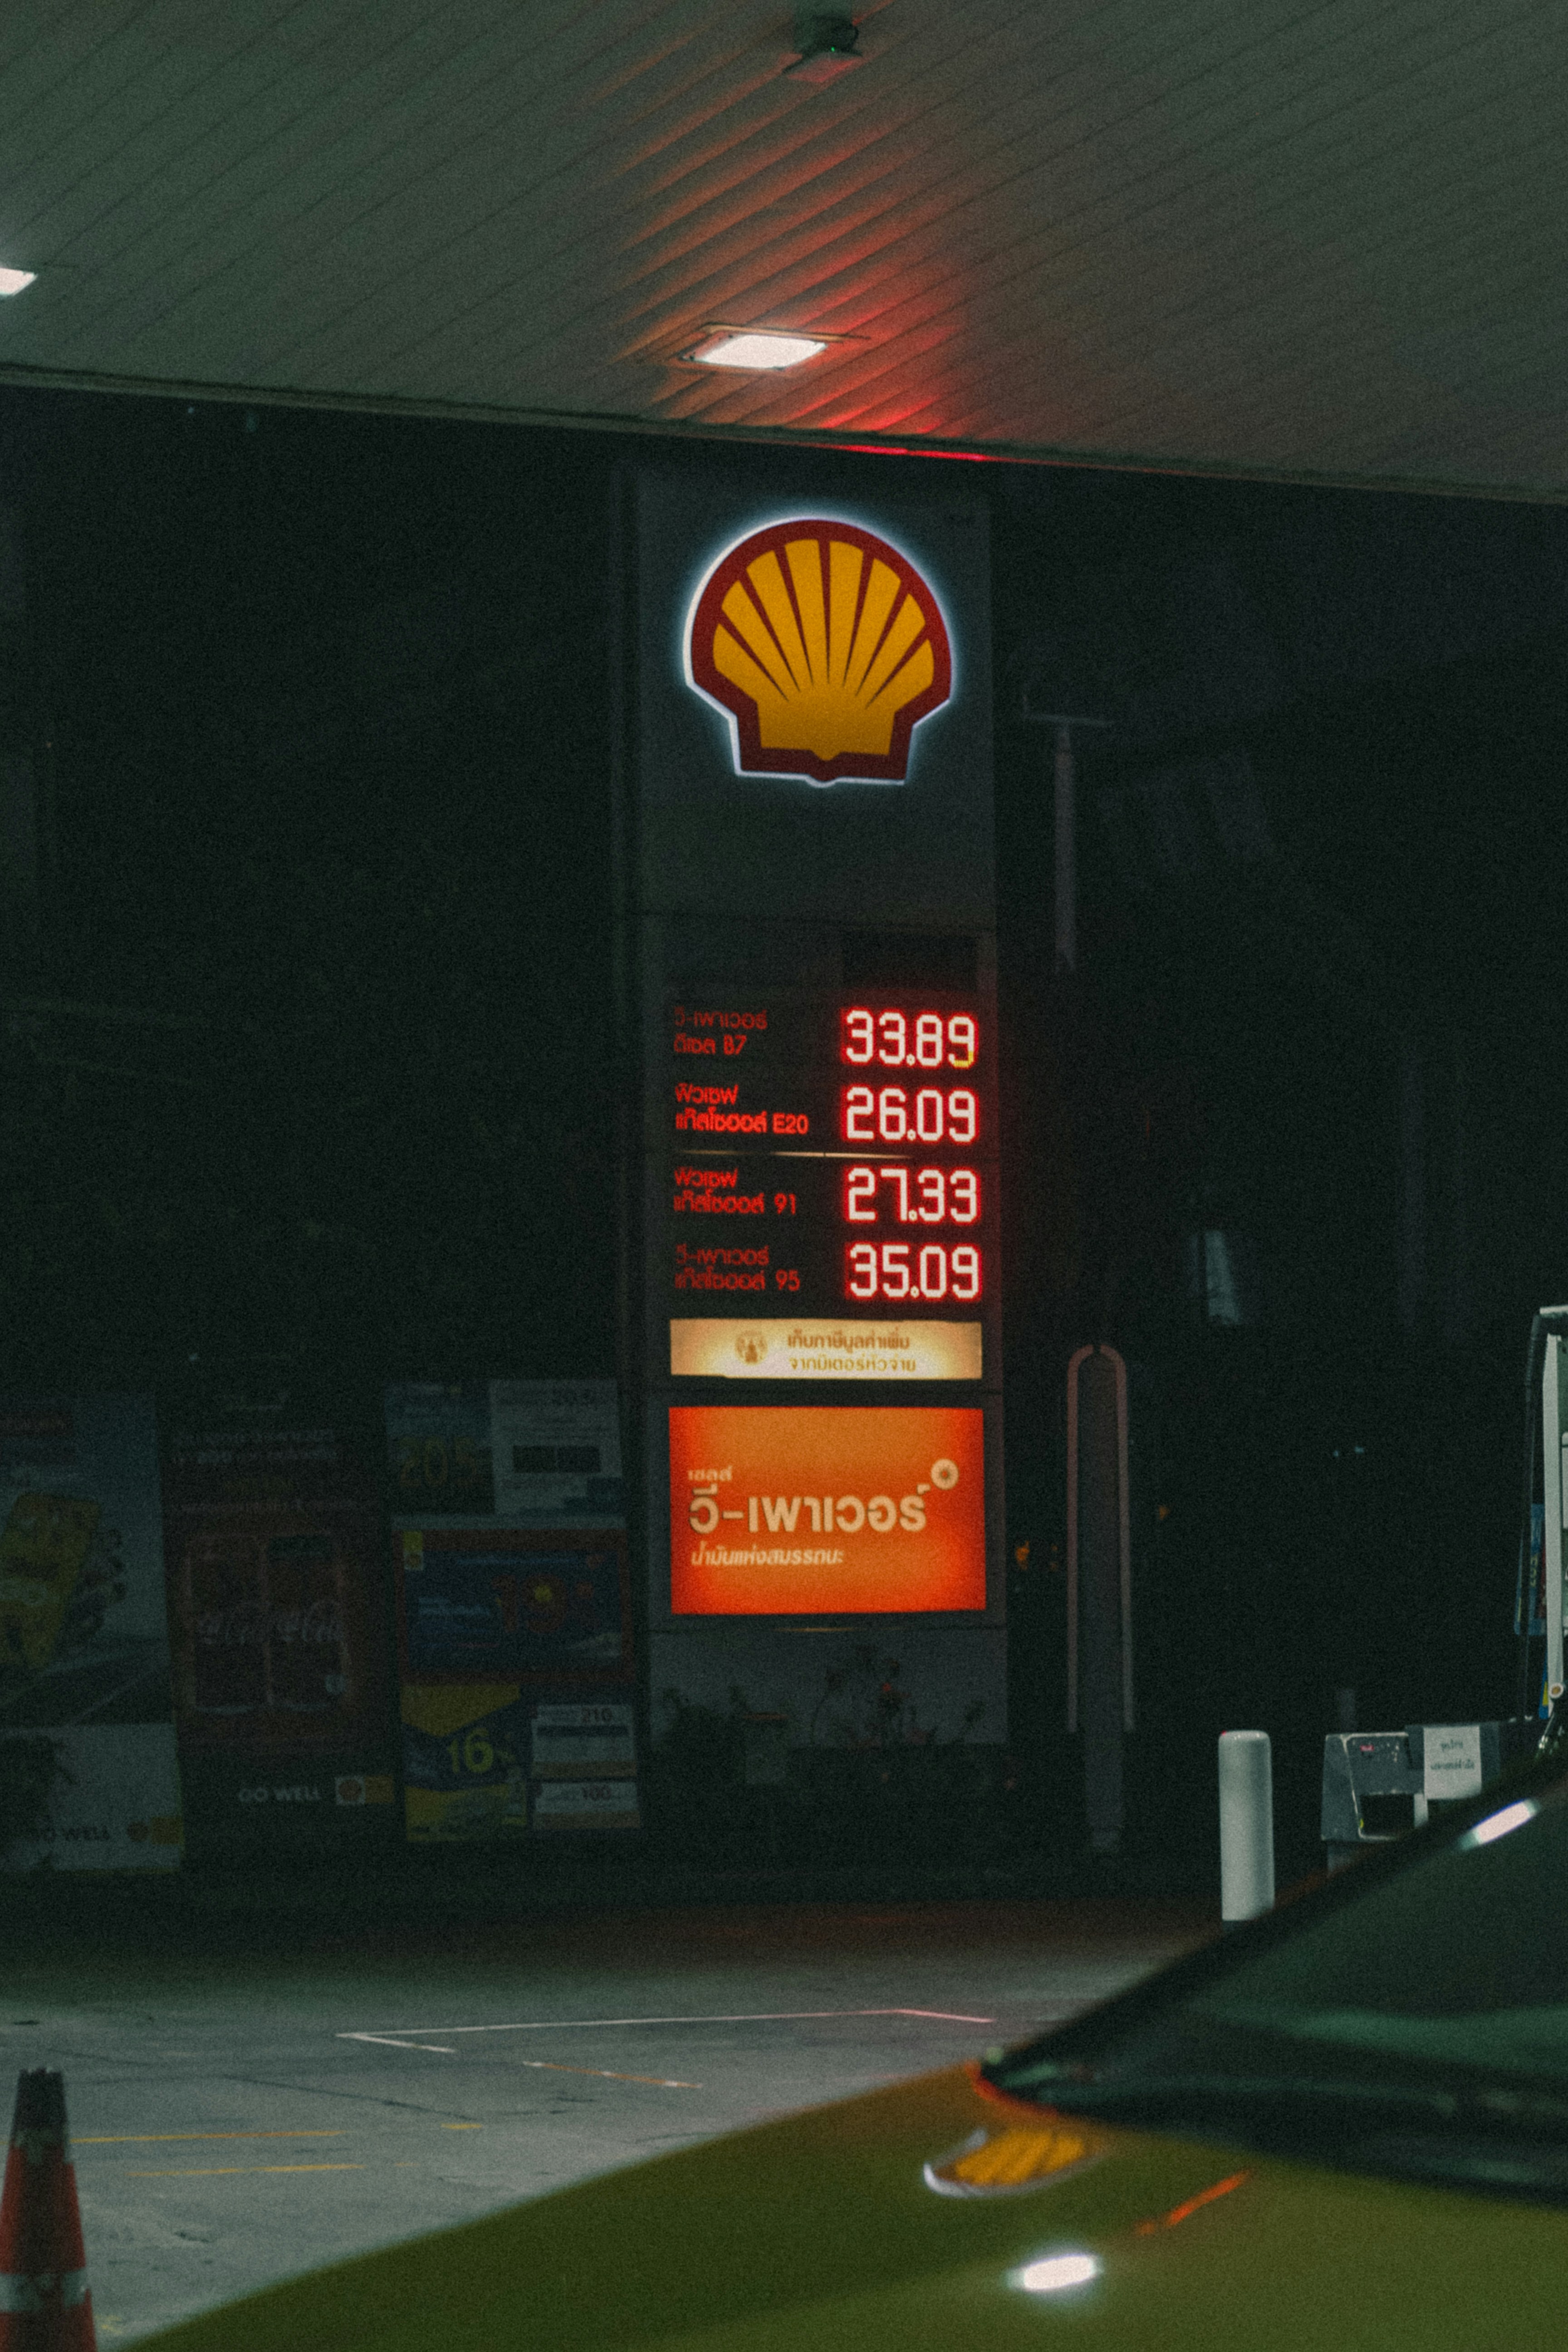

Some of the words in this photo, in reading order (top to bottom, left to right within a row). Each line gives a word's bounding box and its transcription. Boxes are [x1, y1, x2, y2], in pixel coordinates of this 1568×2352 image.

[724, 1034, 747, 1055] B7
[845, 1009, 975, 1067] 33.89
[773, 1112, 809, 1135] E20
[846, 1086, 976, 1142] 26.09
[774, 1192, 796, 1215] 91
[848, 1167, 978, 1223] 27.33
[775, 1269, 800, 1292] 95
[850, 1244, 980, 1299] 35.09
